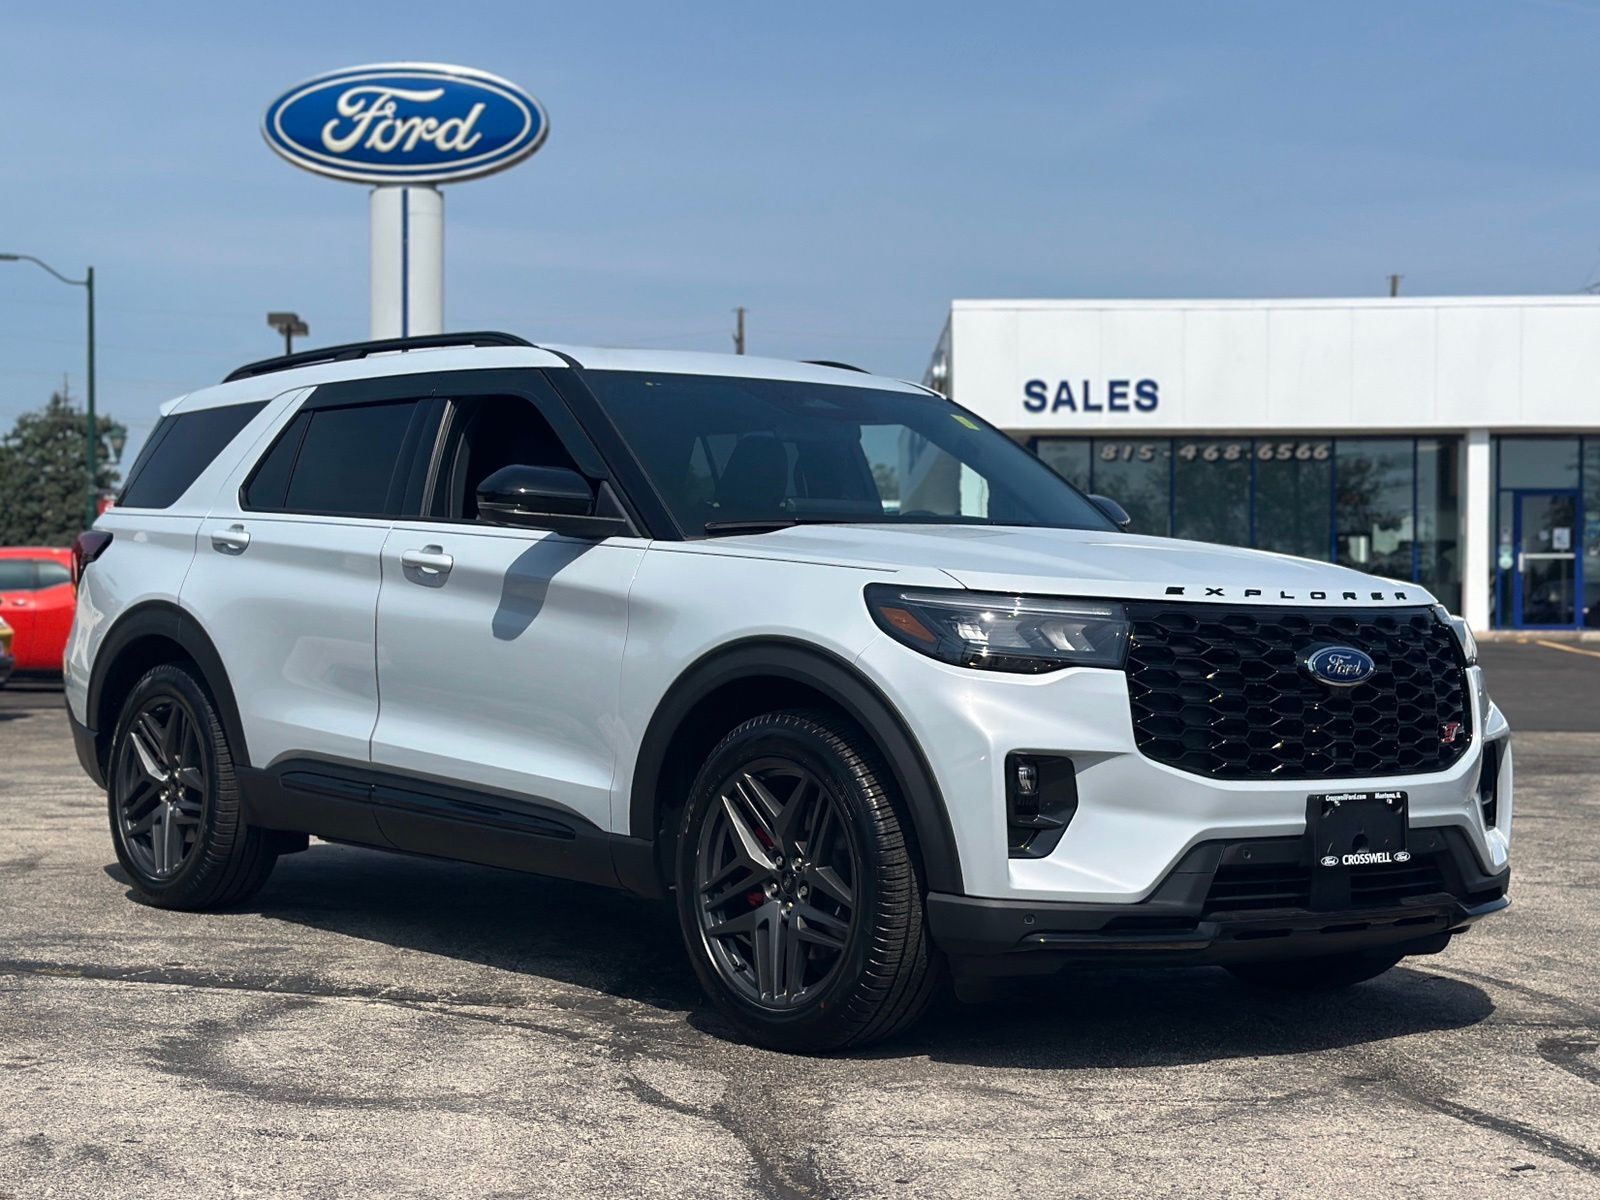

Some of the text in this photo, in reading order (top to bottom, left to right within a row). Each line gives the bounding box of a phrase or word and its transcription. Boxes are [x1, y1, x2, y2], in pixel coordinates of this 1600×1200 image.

[321, 86, 486, 152] Ford
[1023, 379, 1159, 413] SALES
[1165, 586, 1407, 600] EXPLORER
[1327, 654, 1361, 675] Ford
[1342, 852, 1392, 865] CROSSWELL
